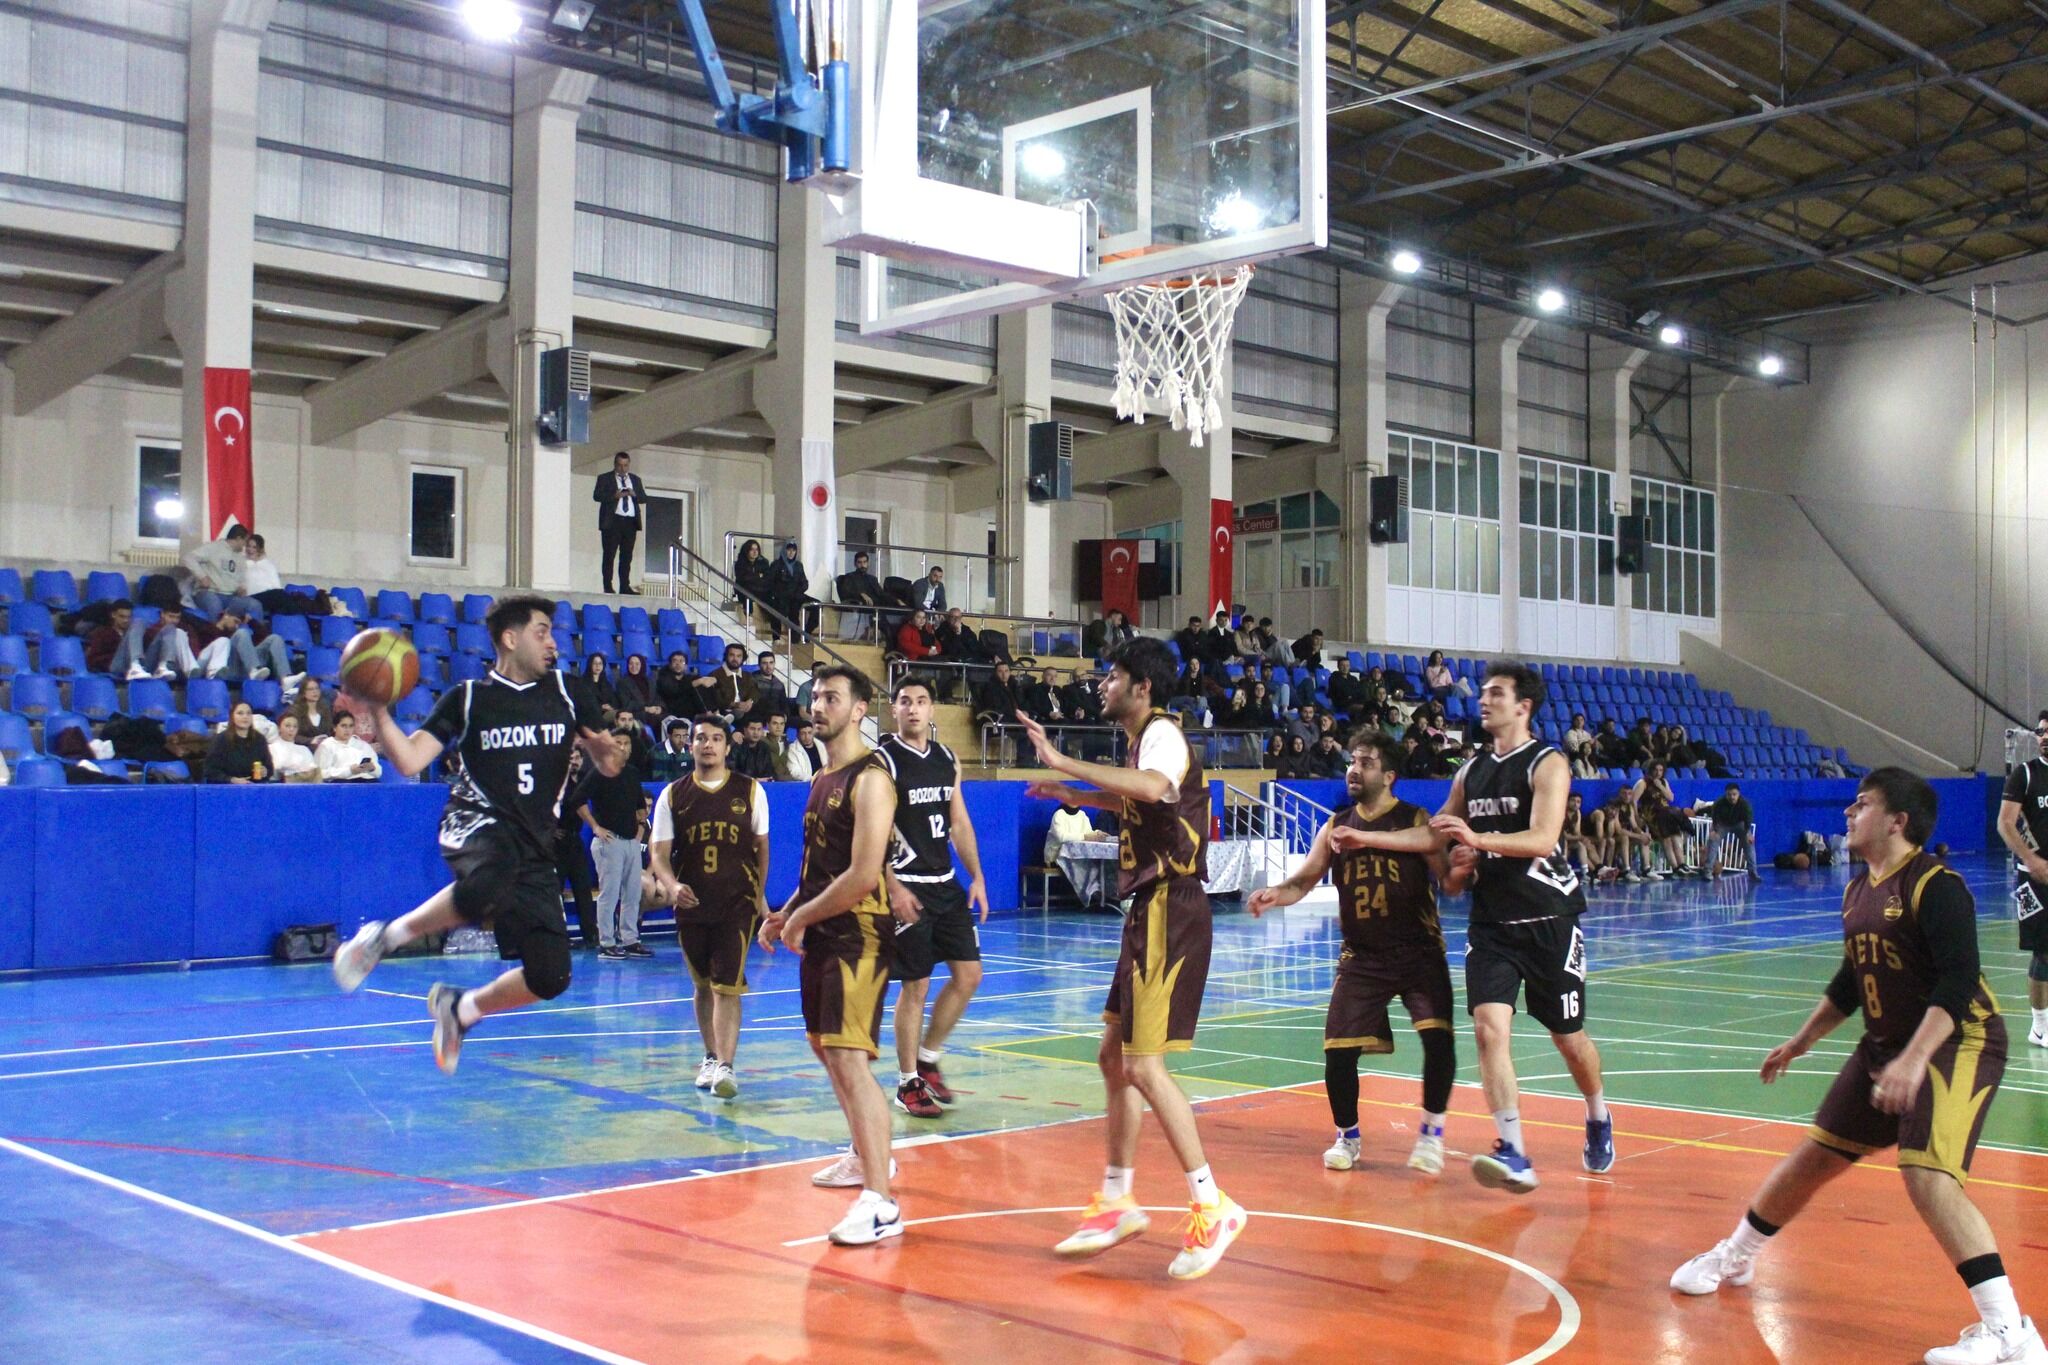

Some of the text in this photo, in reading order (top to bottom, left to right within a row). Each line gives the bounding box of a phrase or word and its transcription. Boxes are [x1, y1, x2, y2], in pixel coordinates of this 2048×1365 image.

[1242, 519, 1275, 531] Center
[480, 723, 566, 751] BOZOK TIP
[518, 763, 534, 794] 5
[908, 786, 955, 805] BOZOK TI
[686, 821, 739, 844] VETS
[929, 814, 945, 838] 12
[704, 845, 718, 873] 9
[1355, 884, 1388, 919] 24
[1561, 990, 1579, 1019] 16
[1864, 974, 1882, 1018] 8
